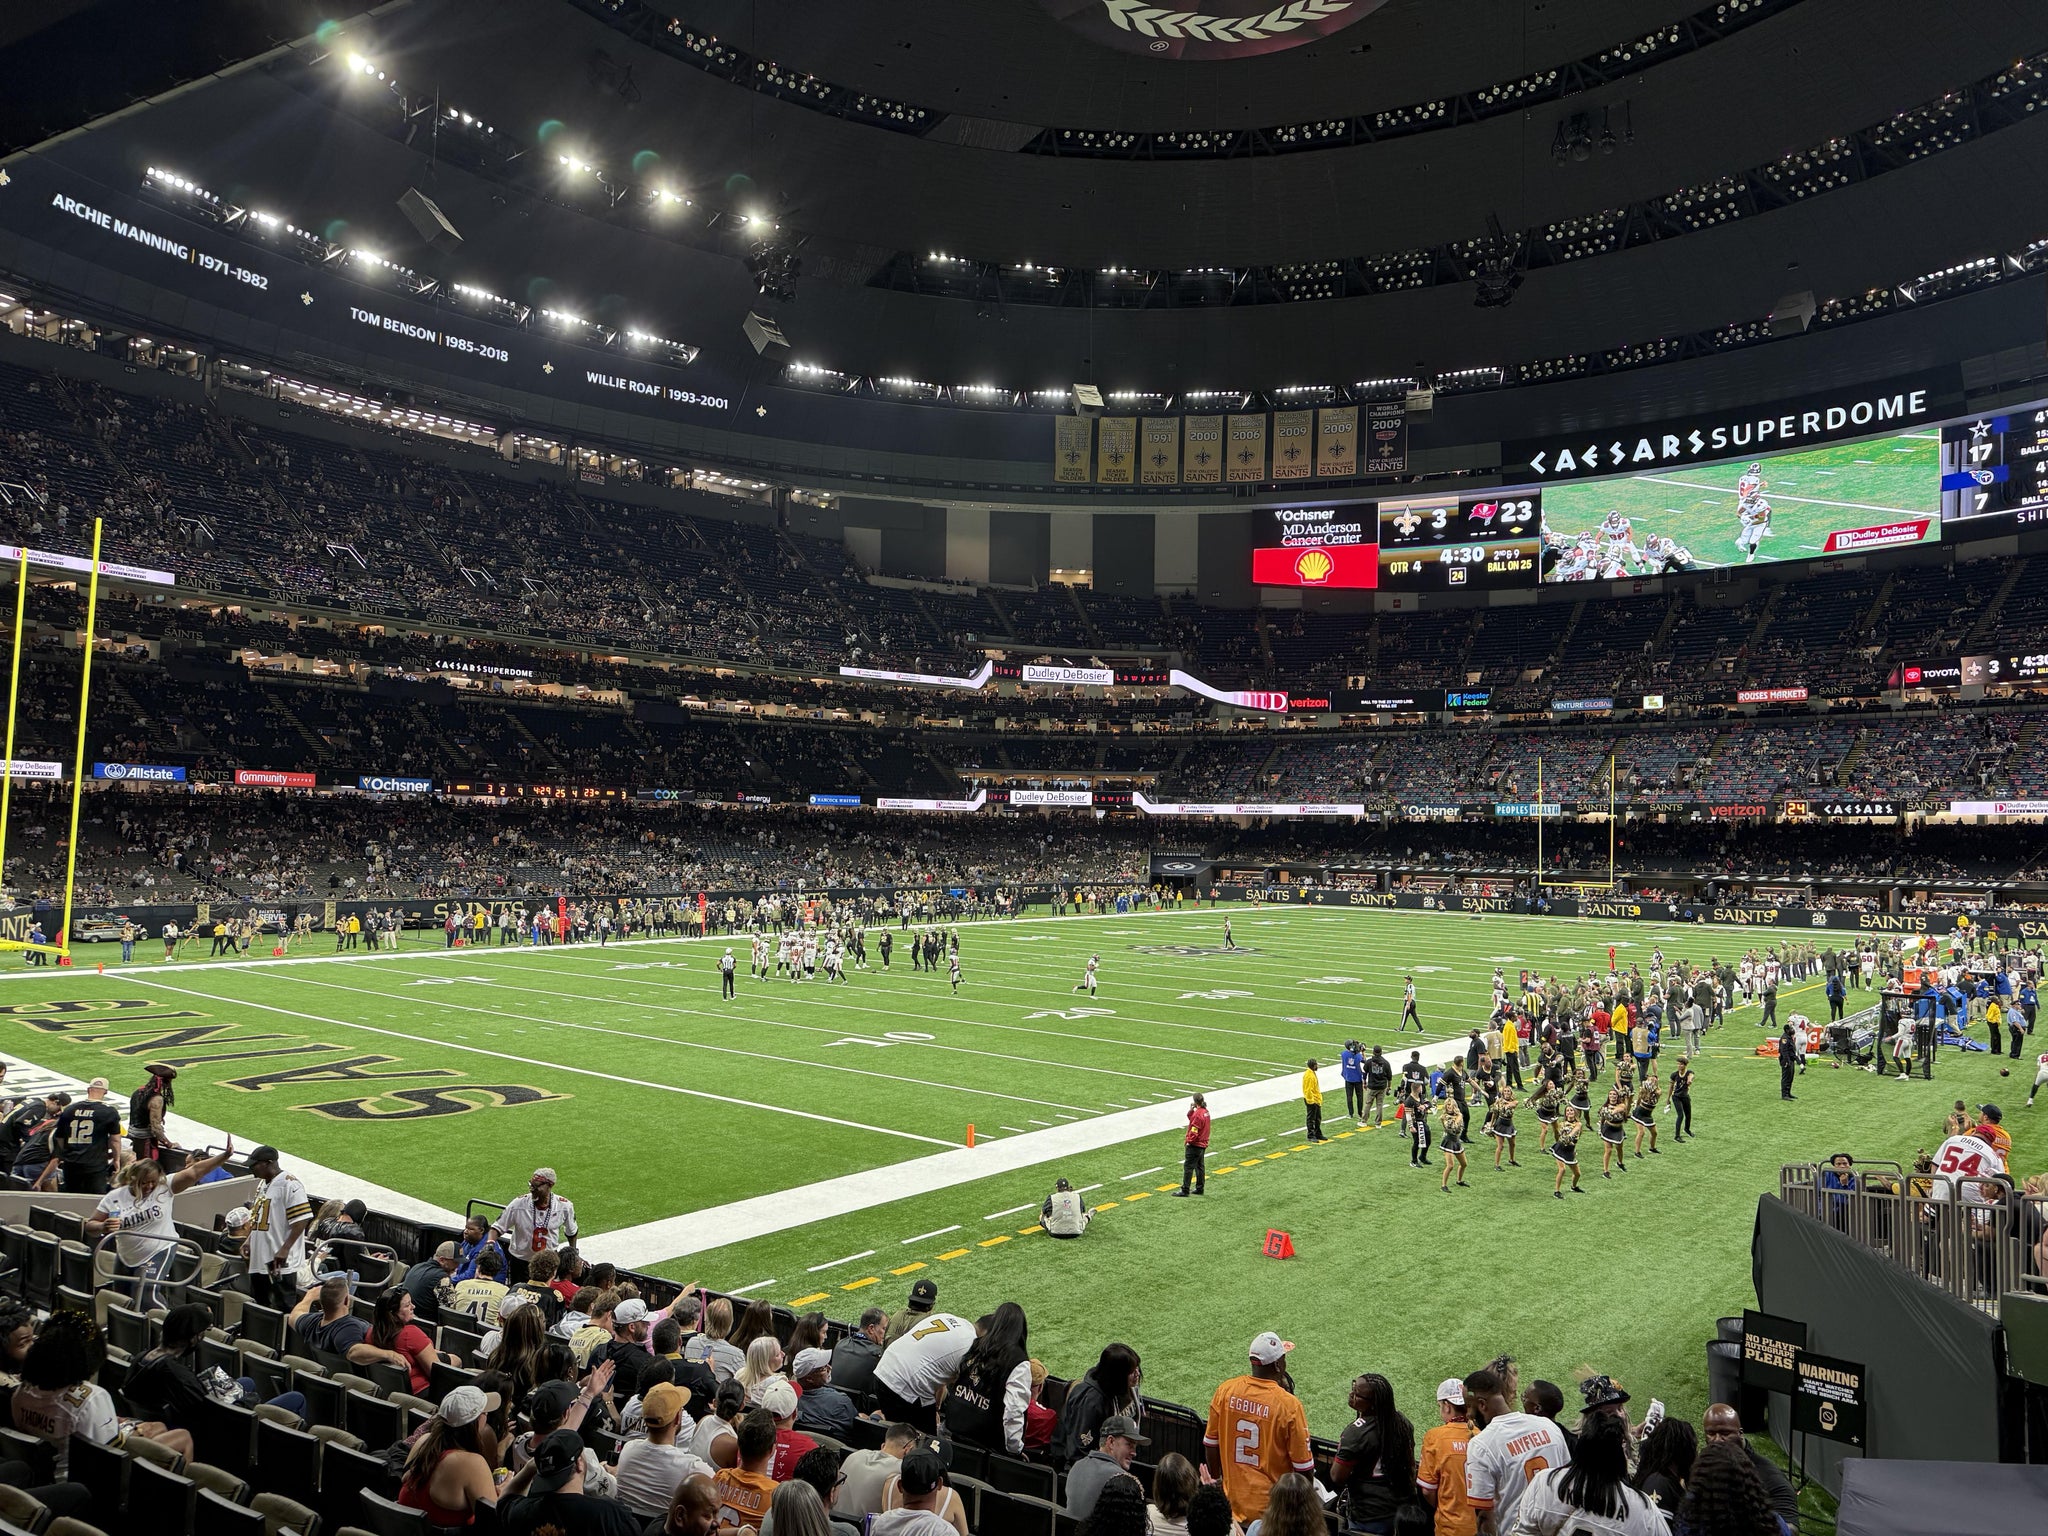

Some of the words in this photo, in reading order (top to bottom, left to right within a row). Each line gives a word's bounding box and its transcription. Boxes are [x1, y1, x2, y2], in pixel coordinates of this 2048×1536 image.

[53, 193, 110, 229] ARCHIE
[113, 218, 188, 262] MANNING
[350, 307, 381, 327] TOM
[383, 319, 437, 343] BENSON
[587, 371, 628, 391] WILLIE
[629, 383, 662, 397] ROAF
[1369, 409, 1406, 418] CHAMPIONS
[1376, 404, 1399, 412] WORLD
[1323, 423, 1353, 435] 2009
[1372, 418, 1402, 431] 2009
[1149, 432, 1173, 445] 1991
[1190, 432, 1219, 443] 2000
[1232, 431, 1261, 443] 2006
[1279, 426, 1308, 438] 2009
[1529, 429, 1708, 477] CAESARS
[1711, 388, 1928, 453] SUPERDOME
[1968, 442, 1993, 463] 17
[2020, 446, 2041, 456] BALL
[1275, 468, 1309, 479] SAINTS
[1320, 464, 1354, 475] SAINTS
[1368, 461, 1403, 473] SAINTS
[1143, 474, 1176, 485] SAINTS
[1186, 474, 1219, 483] SAINTS
[1229, 472, 1263, 482] SAINTS
[1974, 493, 1989, 511] 7
[2021, 495, 2042, 506] BALL
[1282, 510, 1335, 522] Ochsner
[1500, 500, 1533, 523] 23
[1431, 508, 1448, 529] 3
[1282, 525, 1304, 536] MD
[1304, 522, 1362, 535] Anderson
[1853, 530, 1880, 542] Dudley
[1881, 524, 1919, 538] DeBosier
[1281, 535, 1324, 547] Cancer
[1323, 533, 1363, 546] Center
[1439, 547, 1486, 565] 4:30
[1513, 548, 1521, 559] 9
[1390, 561, 1409, 576] QTR
[1412, 560, 1422, 572] 4
[1487, 561, 1507, 573] BALL
[1507, 560, 1520, 571] ON
[1520, 559, 1533, 571] 25
[1451, 570, 1465, 581] 24
[180, 575, 222, 591] SAINTS
[268, 590, 308, 604] SAINTS
[349, 602, 386, 615] SAINTS
[425, 613, 461, 626] SAINTS
[497, 623, 531, 636] SAINTS
[249, 638, 286, 652] SAINTS
[565, 634, 597, 645] SAINTS
[327, 648, 361, 660] SAINTS
[435, 660, 482, 673] CAESARS
[483, 665, 533, 679] SUPERDOME
[1027, 666, 1060, 682] Dudley
[1062, 668, 1107, 683] DeBosier
[1923, 669, 1961, 680] TOYOTA
[1988, 660, 2000, 676] 3
[1116, 674, 1167, 683] Lawyers
[1738, 691, 1769, 703] ROUSES
[1770, 689, 1807, 701] MARKETS
[1818, 686, 1854, 696] SAINTS
[1289, 698, 1329, 708] verizon
[1552, 702, 1584, 712] VENTURE
[1584, 700, 1613, 710] GLOBAL
[240, 771, 288, 784] Community
[371, 777, 430, 793] Ochsner
[654, 789, 680, 800] COX
[746, 795, 772, 804] entergy
[1014, 792, 1045, 804] Dudley
[1046, 793, 1087, 803] DeBosier
[1408, 804, 1460, 817] Ochsner
[1496, 805, 1529, 815] PEOPLES
[1577, 804, 1609, 812] SAINTS
[1650, 804, 1684, 812] SAINTS
[1709, 803, 1766, 817] verizon
[1787, 803, 1806, 815] 24
[1824, 803, 1894, 815] CAESARS
[1906, 801, 1947, 811] SAINTS
[1714, 908, 1774, 923] SAINTS
[1859, 914, 1928, 931] SAINTS
[68, 1119, 95, 1145] 12
[1959, 1136, 1985, 1152] DAVID
[1940, 1145, 1983, 1178] 54
[532, 1227, 549, 1253] 6
[1267, 1232, 1284, 1256] G
[467, 1289, 493, 1297] KAMARA
[465, 1301, 489, 1323] 41
[912, 1318, 950, 1342] 7
[1745, 1333, 1760, 1344] NO
[1798, 1362, 1859, 1390] WARNING
[1802, 1378, 1823, 1389] SMART
[1824, 1382, 1855, 1396] WATCHES
[1803, 1384, 1817, 1392] ARE
[1817, 1386, 1854, 1401] PROHIBITED
[954, 1384, 991, 1412] SAINTS
[1798, 1387, 1806, 1395] IN
[1806, 1389, 1818, 1397] THE
[1819, 1391, 1841, 1403] BENCH
[1841, 1397, 1859, 1408] AREA
[1229, 1396, 1271, 1420] EGBUKA
[20, 1408, 57, 1435] THOMAS
[1235, 1418, 1261, 1469] 2
[1506, 1429, 1552, 1457] MAYFIELD
